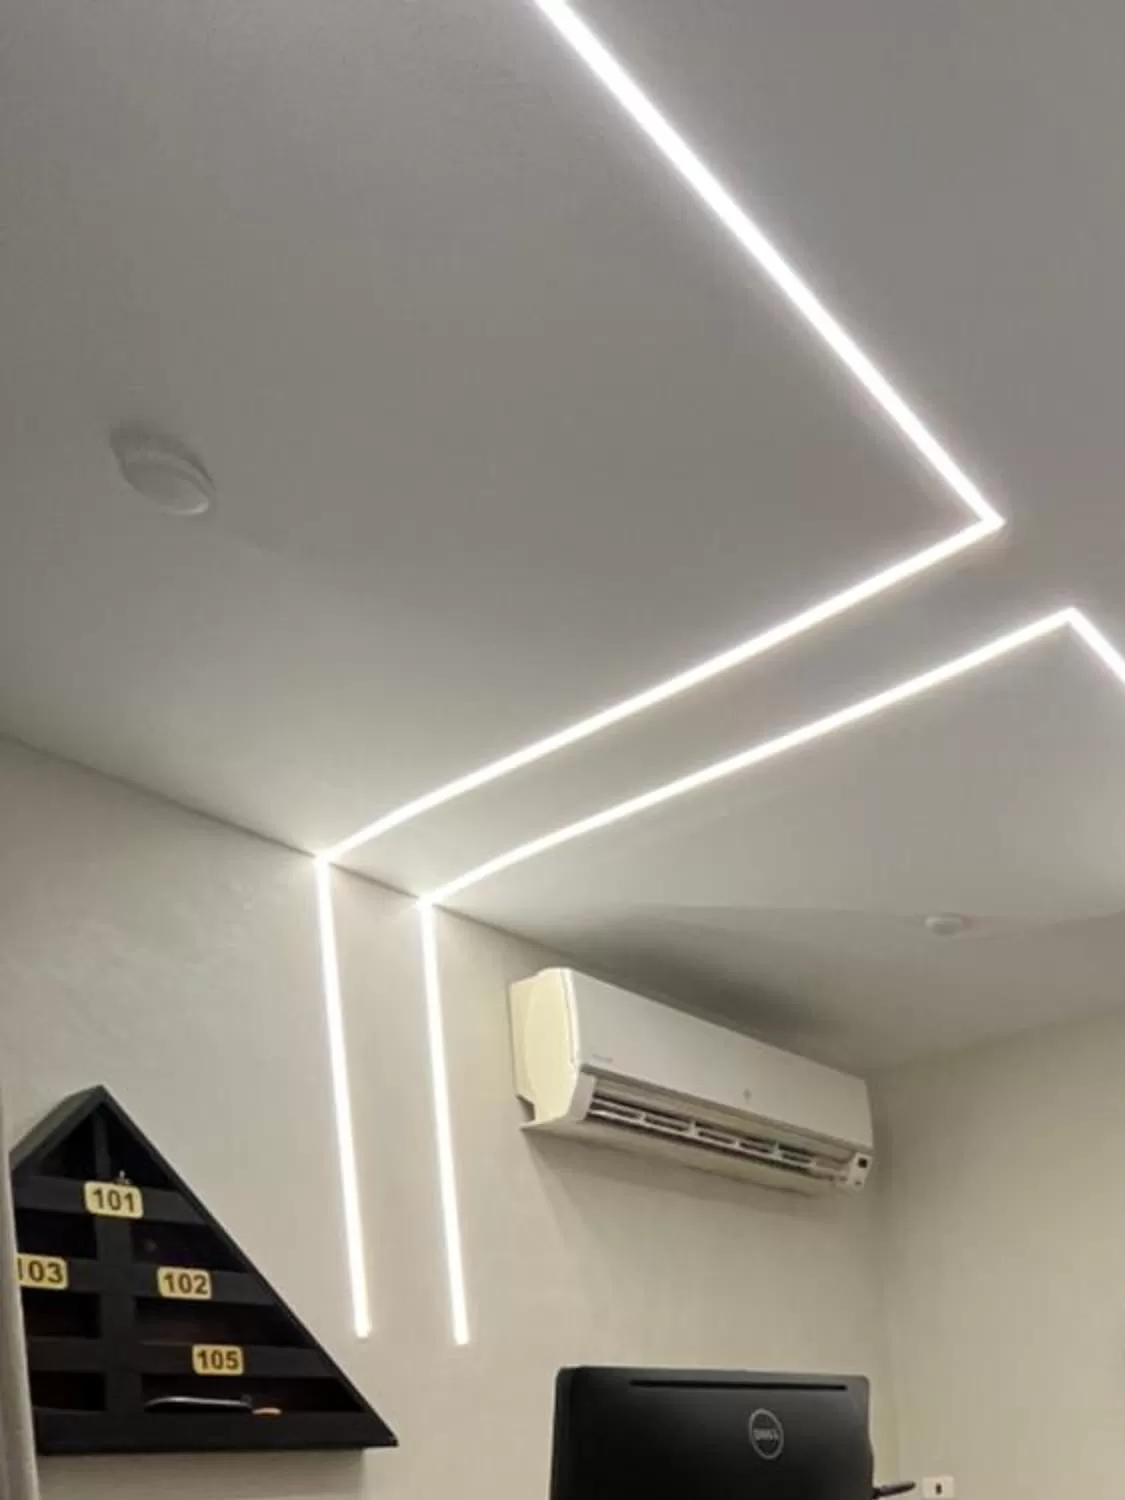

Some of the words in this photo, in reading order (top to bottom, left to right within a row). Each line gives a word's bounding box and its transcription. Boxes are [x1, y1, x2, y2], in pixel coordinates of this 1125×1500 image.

[93, 1187, 135, 1213] 101
[162, 1272, 209, 1295] 102
[197, 1349, 240, 1371] 105
